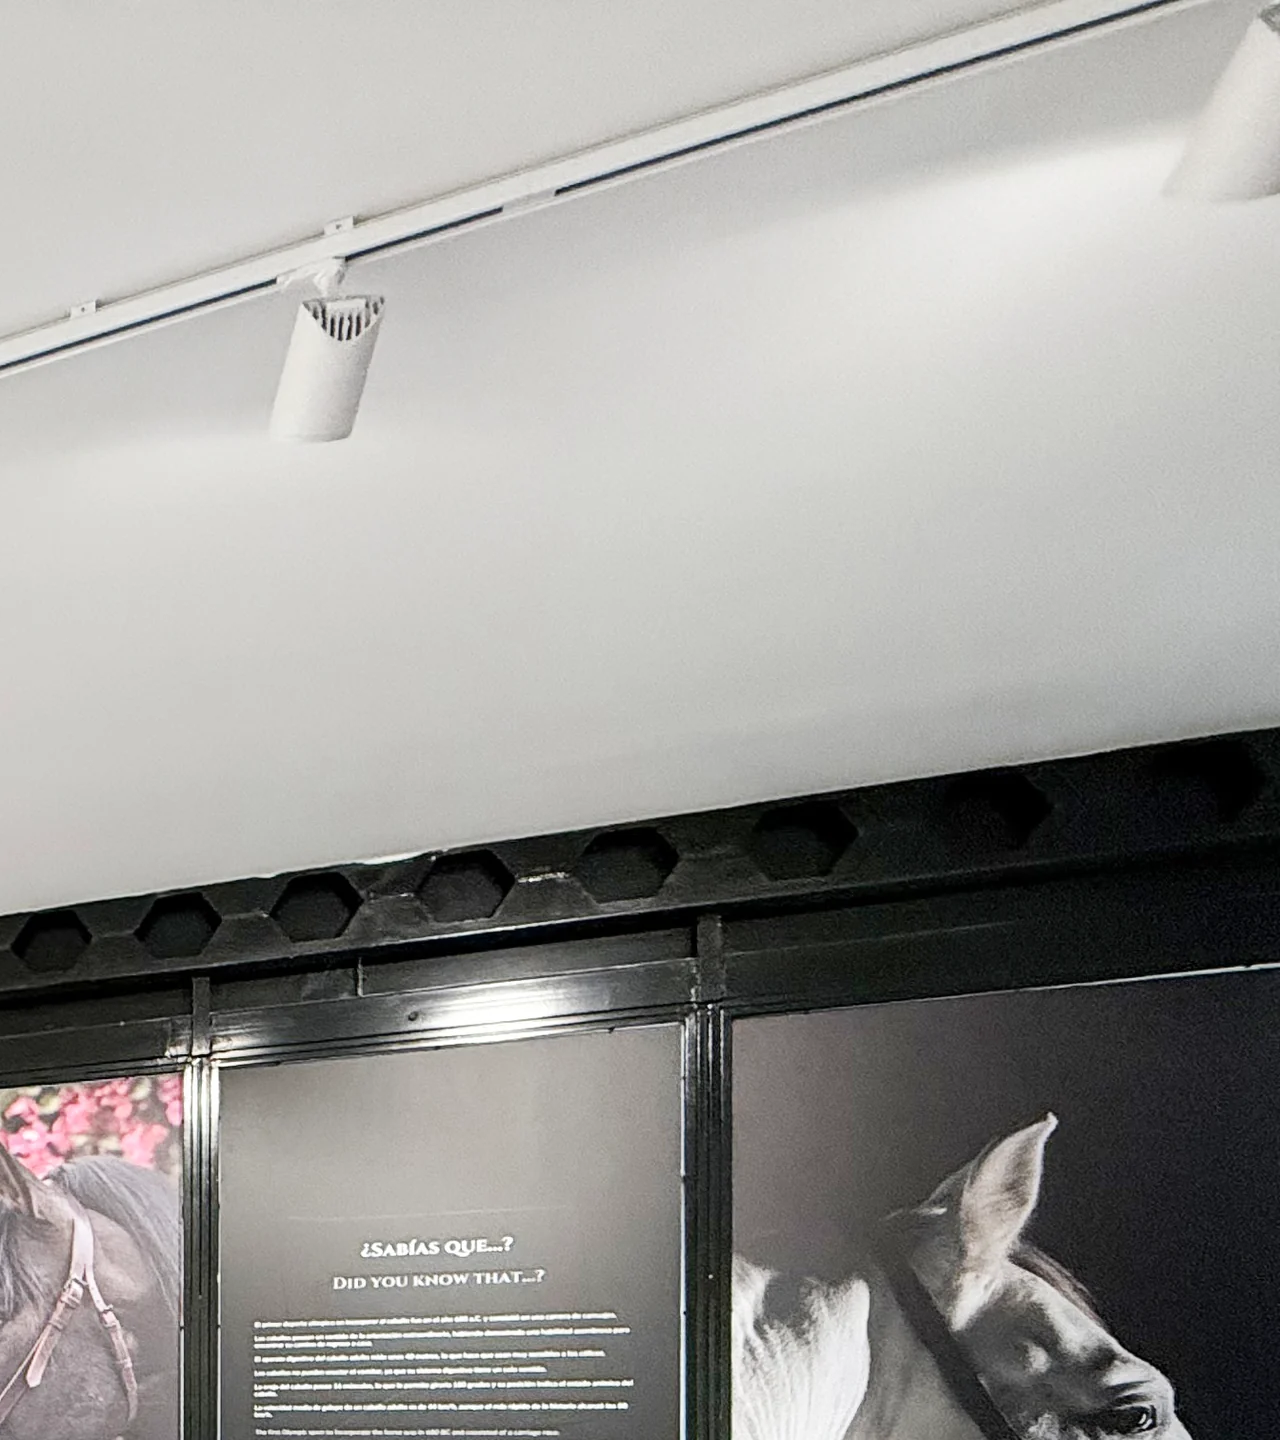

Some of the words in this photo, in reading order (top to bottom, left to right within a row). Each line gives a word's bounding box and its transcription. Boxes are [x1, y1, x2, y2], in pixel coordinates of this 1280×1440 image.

[360, 1239, 440, 1258] ¿SABÍAS
[333, 1277, 366, 1290] DID
[371, 1275, 409, 1288] YOU
[412, 1273, 470, 1287] KNOW
